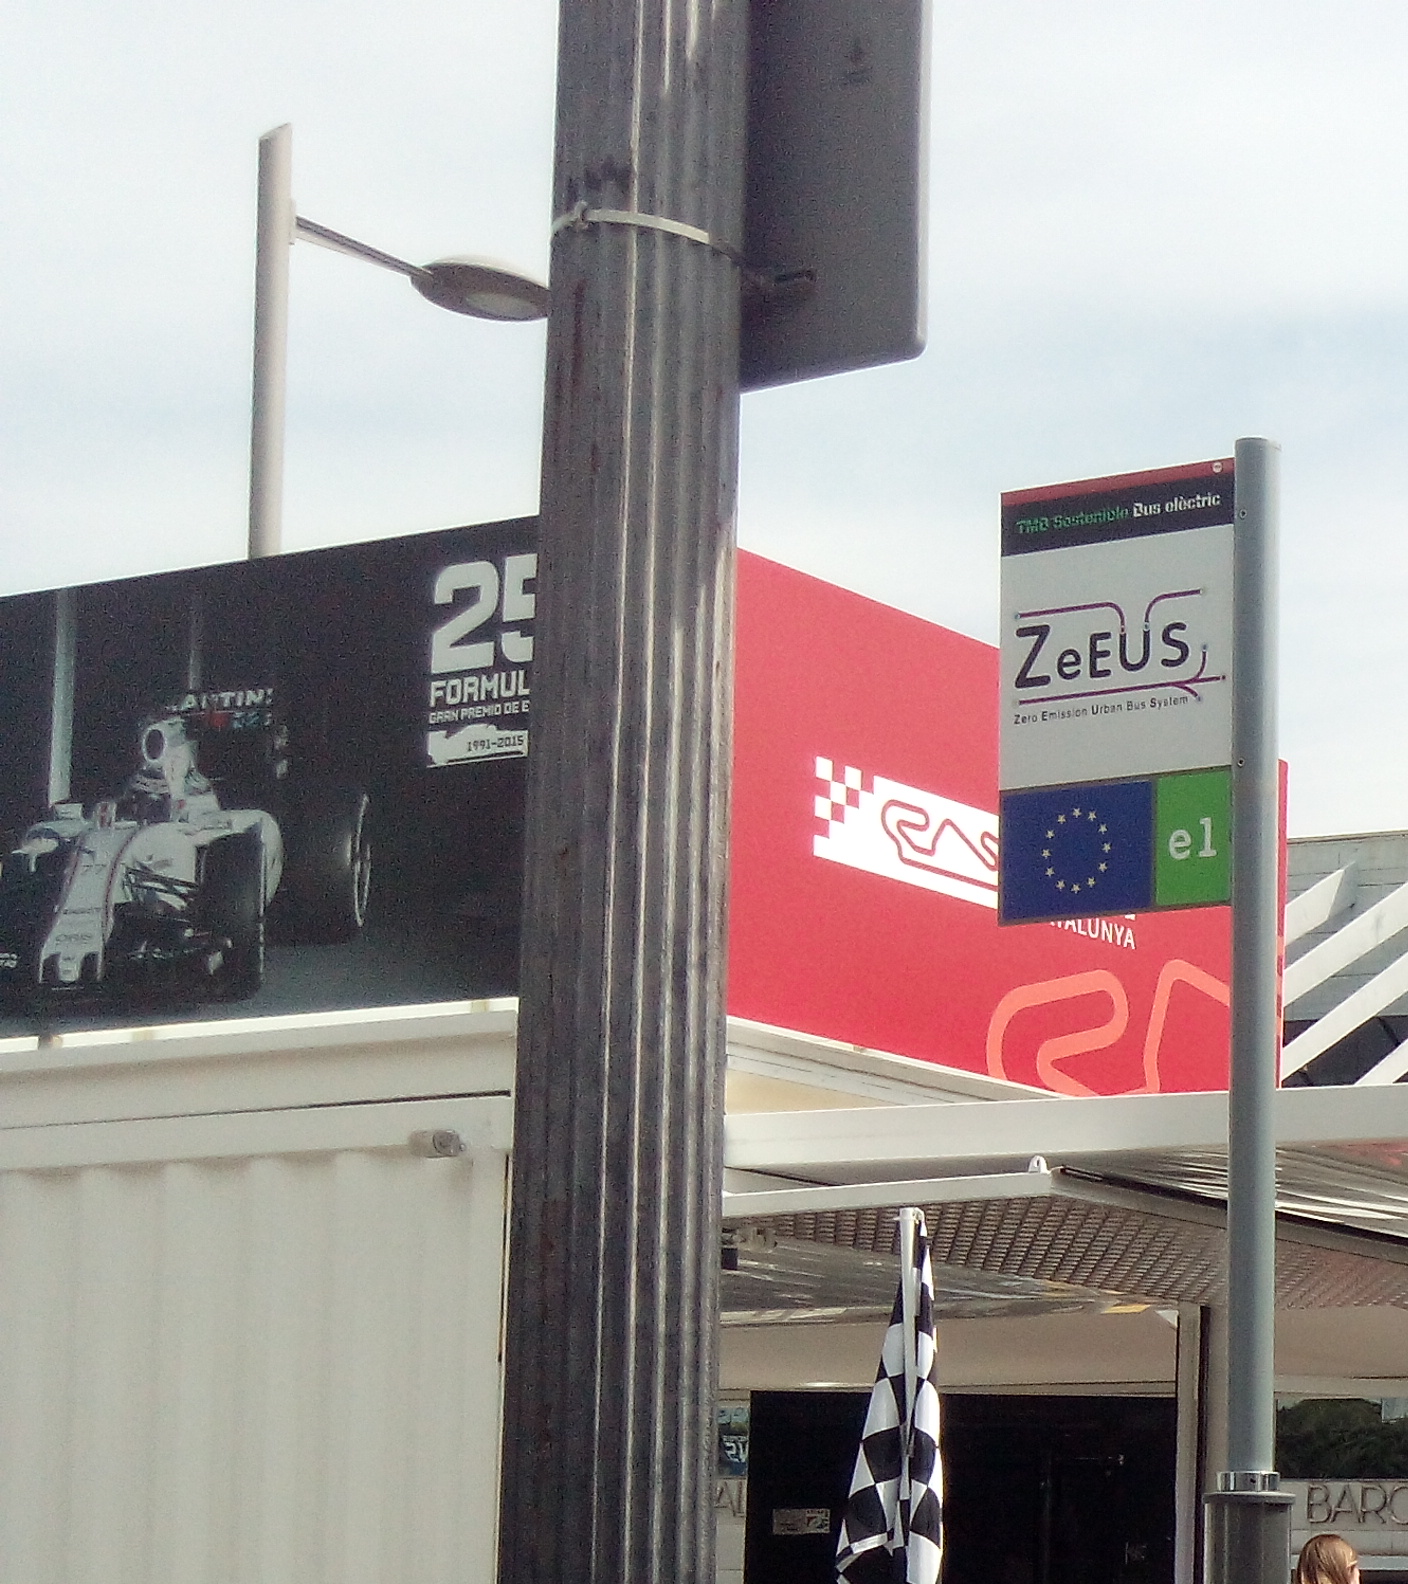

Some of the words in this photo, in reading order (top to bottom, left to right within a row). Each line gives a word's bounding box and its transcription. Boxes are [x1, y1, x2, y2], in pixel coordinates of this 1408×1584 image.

[1133, 501, 1162, 518] Bus
[1014, 621, 1191, 690] ZeEUS
[429, 669, 531, 708] FORMUL
[428, 707, 460, 726] GRAN
[461, 702, 503, 720] PREMIO
[504, 700, 521, 715] DE
[1013, 711, 1039, 726] Zero
[1041, 706, 1089, 723] Emission
[1090, 701, 1124, 717] Urban
[1126, 698, 1147, 713] Bus
[1149, 694, 1189, 711] System
[466, 734, 525, 752] 1991-2015
